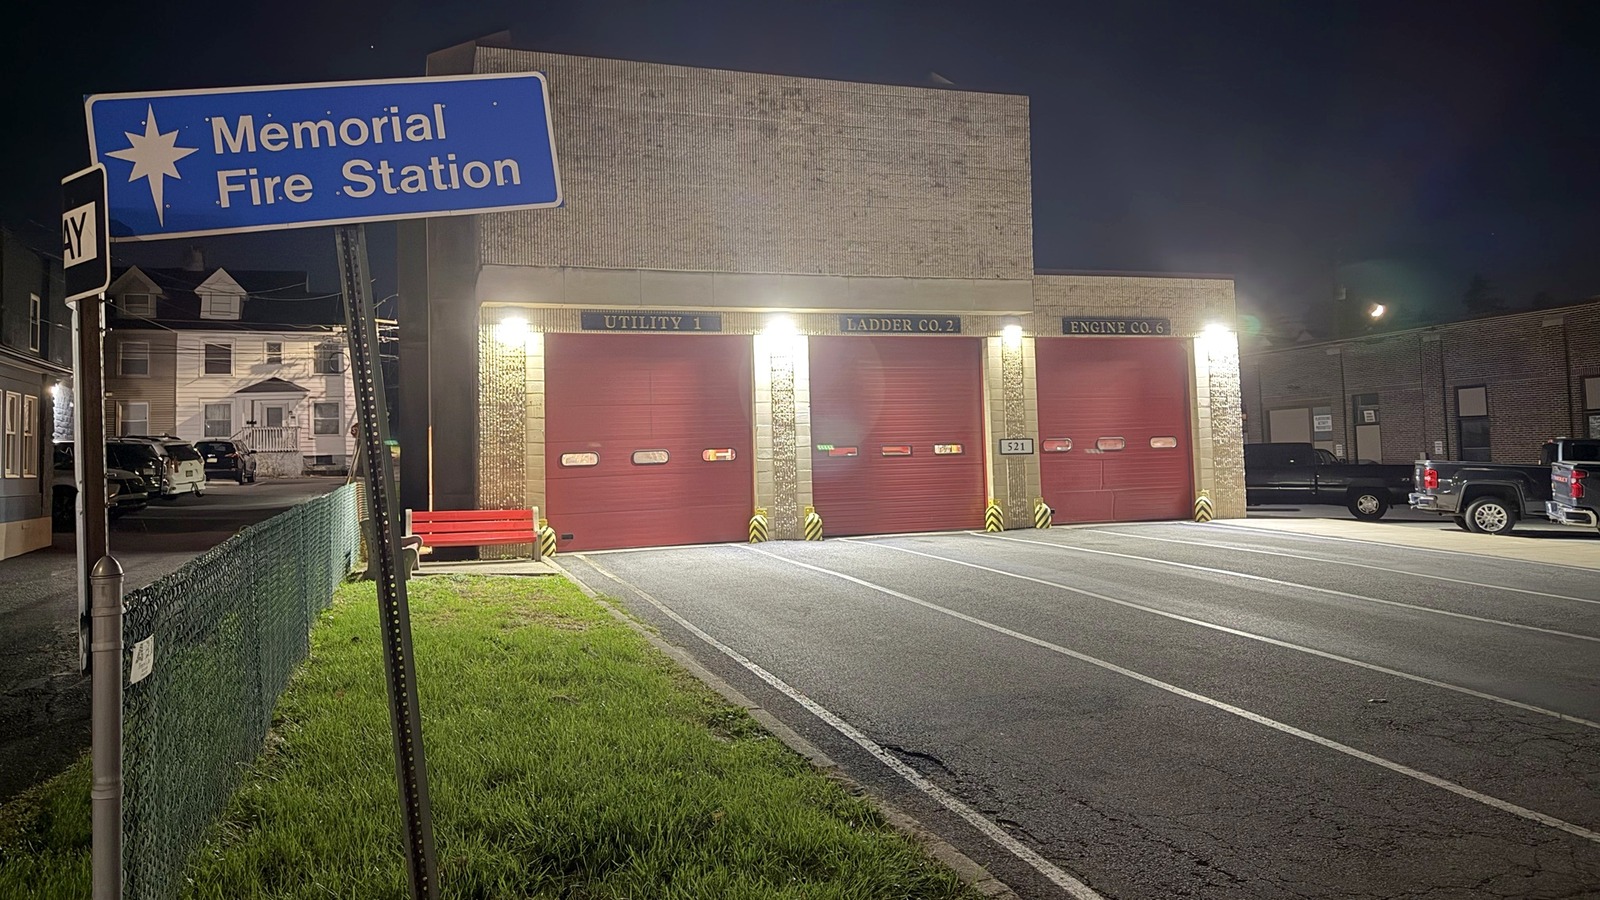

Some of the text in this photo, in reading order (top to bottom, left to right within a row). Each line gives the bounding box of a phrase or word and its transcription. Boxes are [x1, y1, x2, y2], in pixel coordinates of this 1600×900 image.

[211, 104, 446, 154] Memorial
[217, 154, 521, 208] Fire Station
[604, 315, 702, 330] UTILITY 1
[847, 318, 954, 332] LADDER CO. 2
[1070, 321, 1164, 333] ENGINE CO. 6
[1007, 442, 1026, 451] 521
